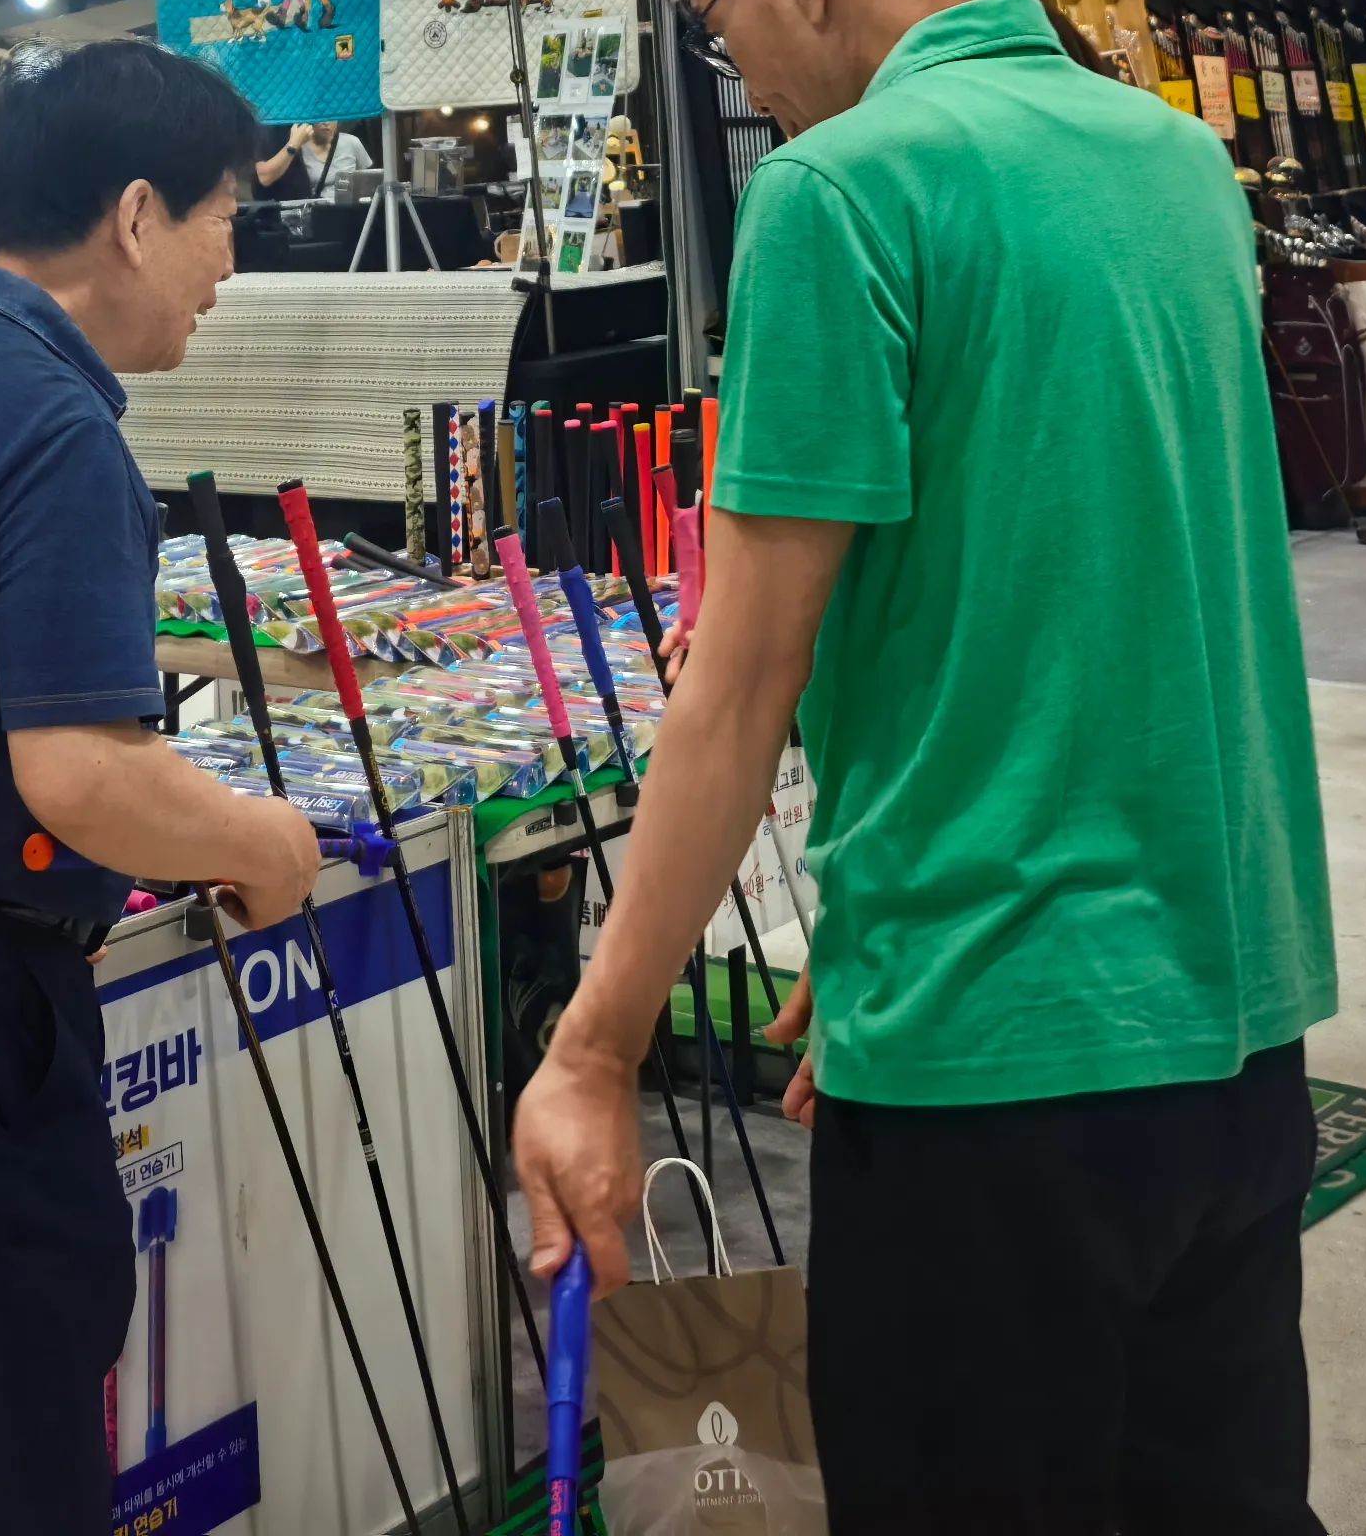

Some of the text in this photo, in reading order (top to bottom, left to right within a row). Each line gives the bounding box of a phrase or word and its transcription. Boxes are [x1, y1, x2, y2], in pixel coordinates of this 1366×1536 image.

[313, 795, 345, 811] Easy
[140, 1150, 176, 1181] 연습기
[694, 1468, 754, 1493] OTT
